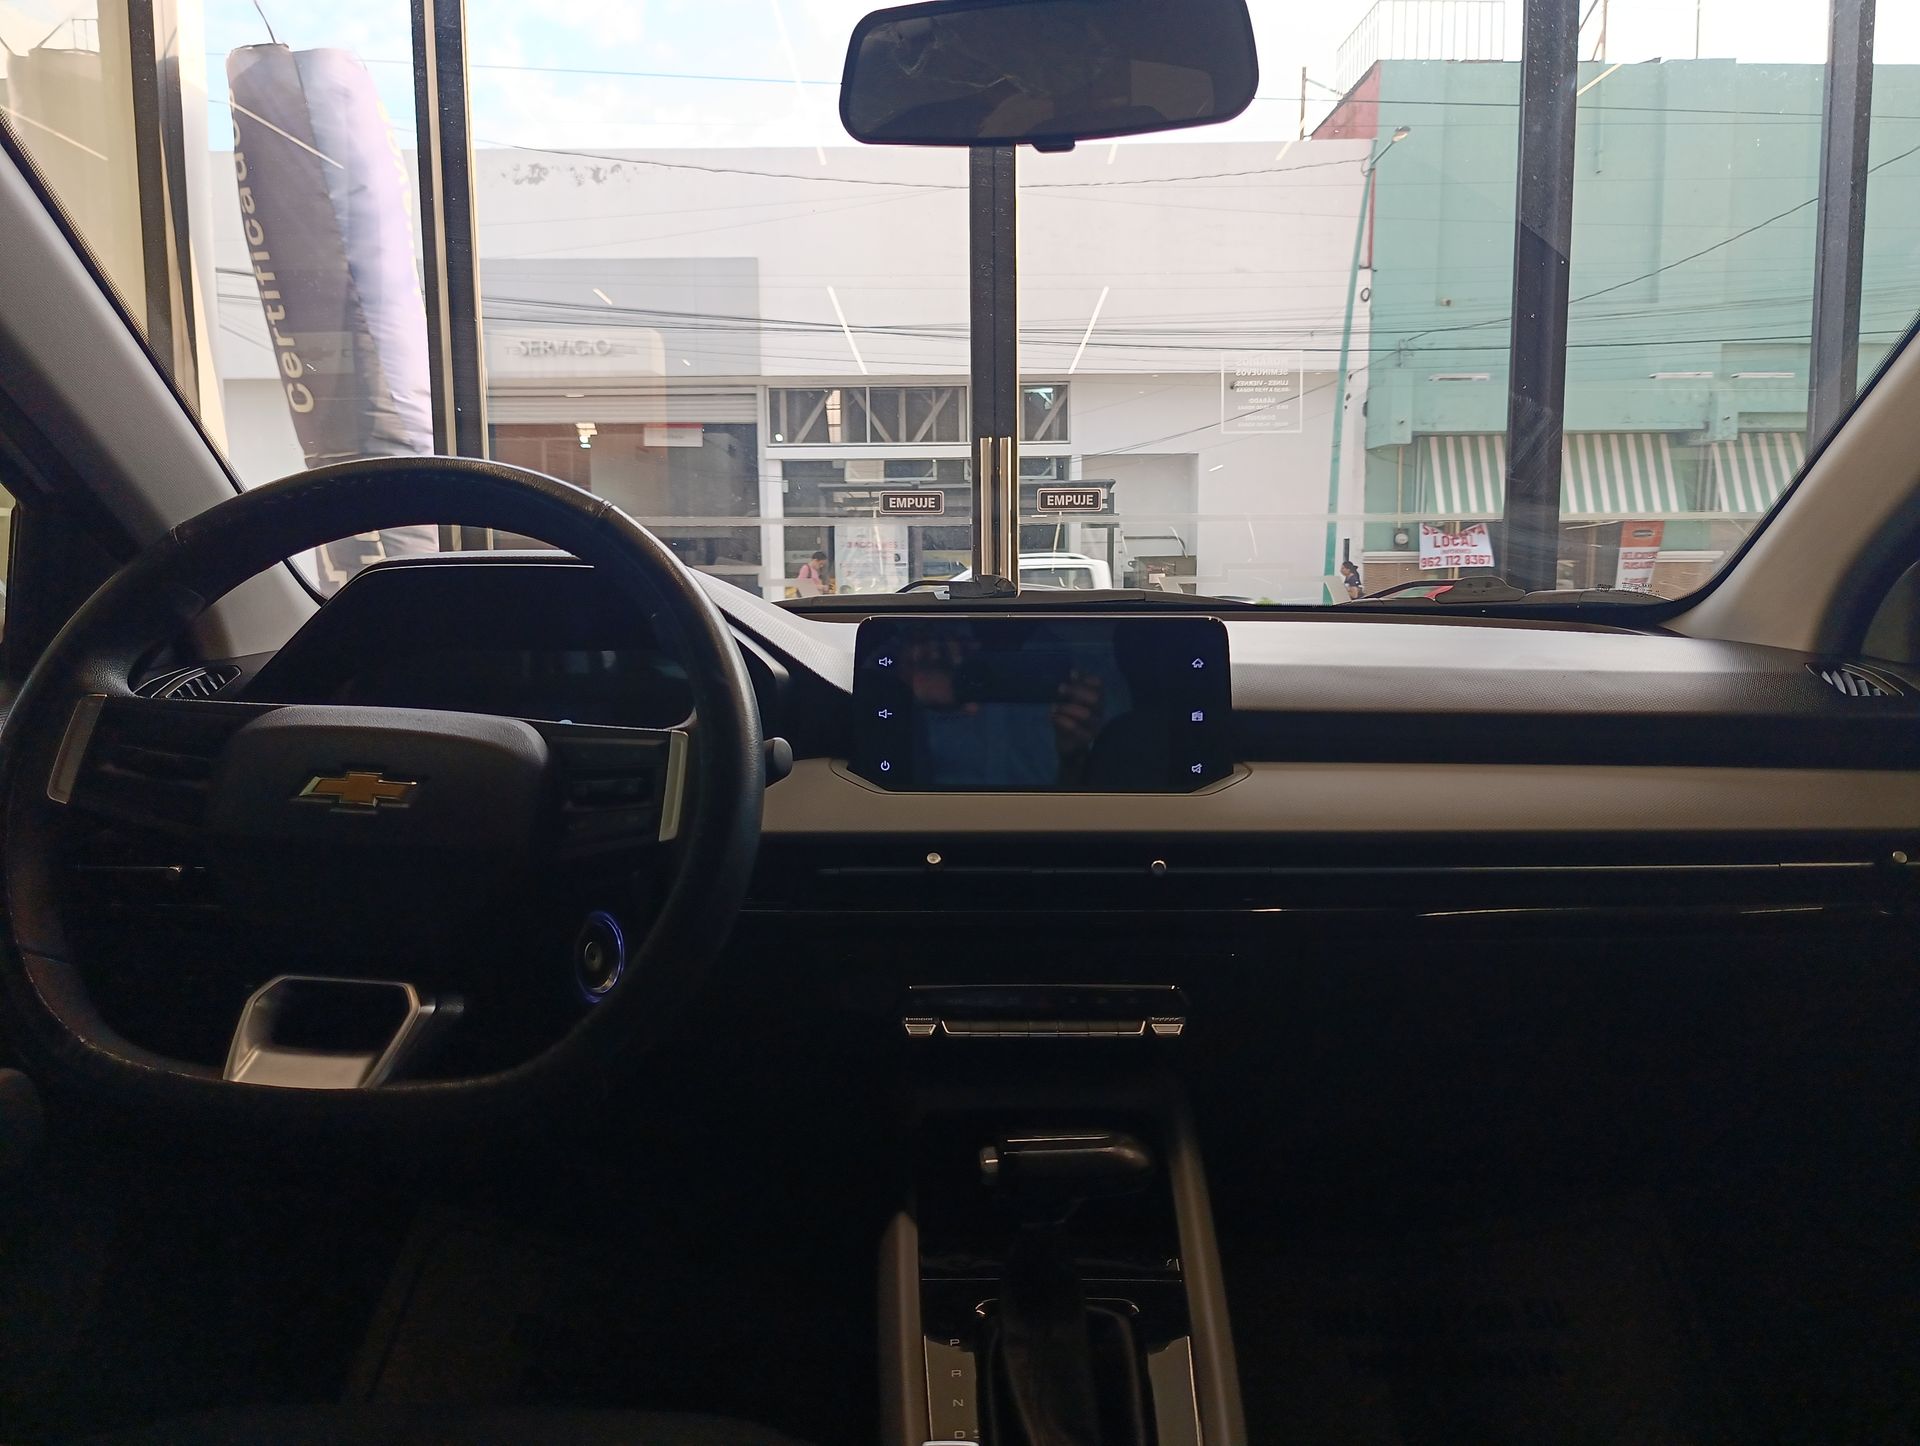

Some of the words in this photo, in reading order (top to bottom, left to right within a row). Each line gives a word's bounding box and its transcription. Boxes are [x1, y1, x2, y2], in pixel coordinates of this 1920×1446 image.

[889, 497, 936, 509] EMPUJE
[1046, 494, 1094, 506] EMPUJE
[1433, 535, 1478, 548] LOCAL
[1421, 556, 1441, 568] 962
[1445, 555, 1461, 566] 112
[1464, 554, 1491, 565] 8367
[949, 1338, 960, 1347] P
[951, 1369, 962, 1377] R
[952, 1399, 964, 1407] N
[954, 1430, 966, 1439] D
